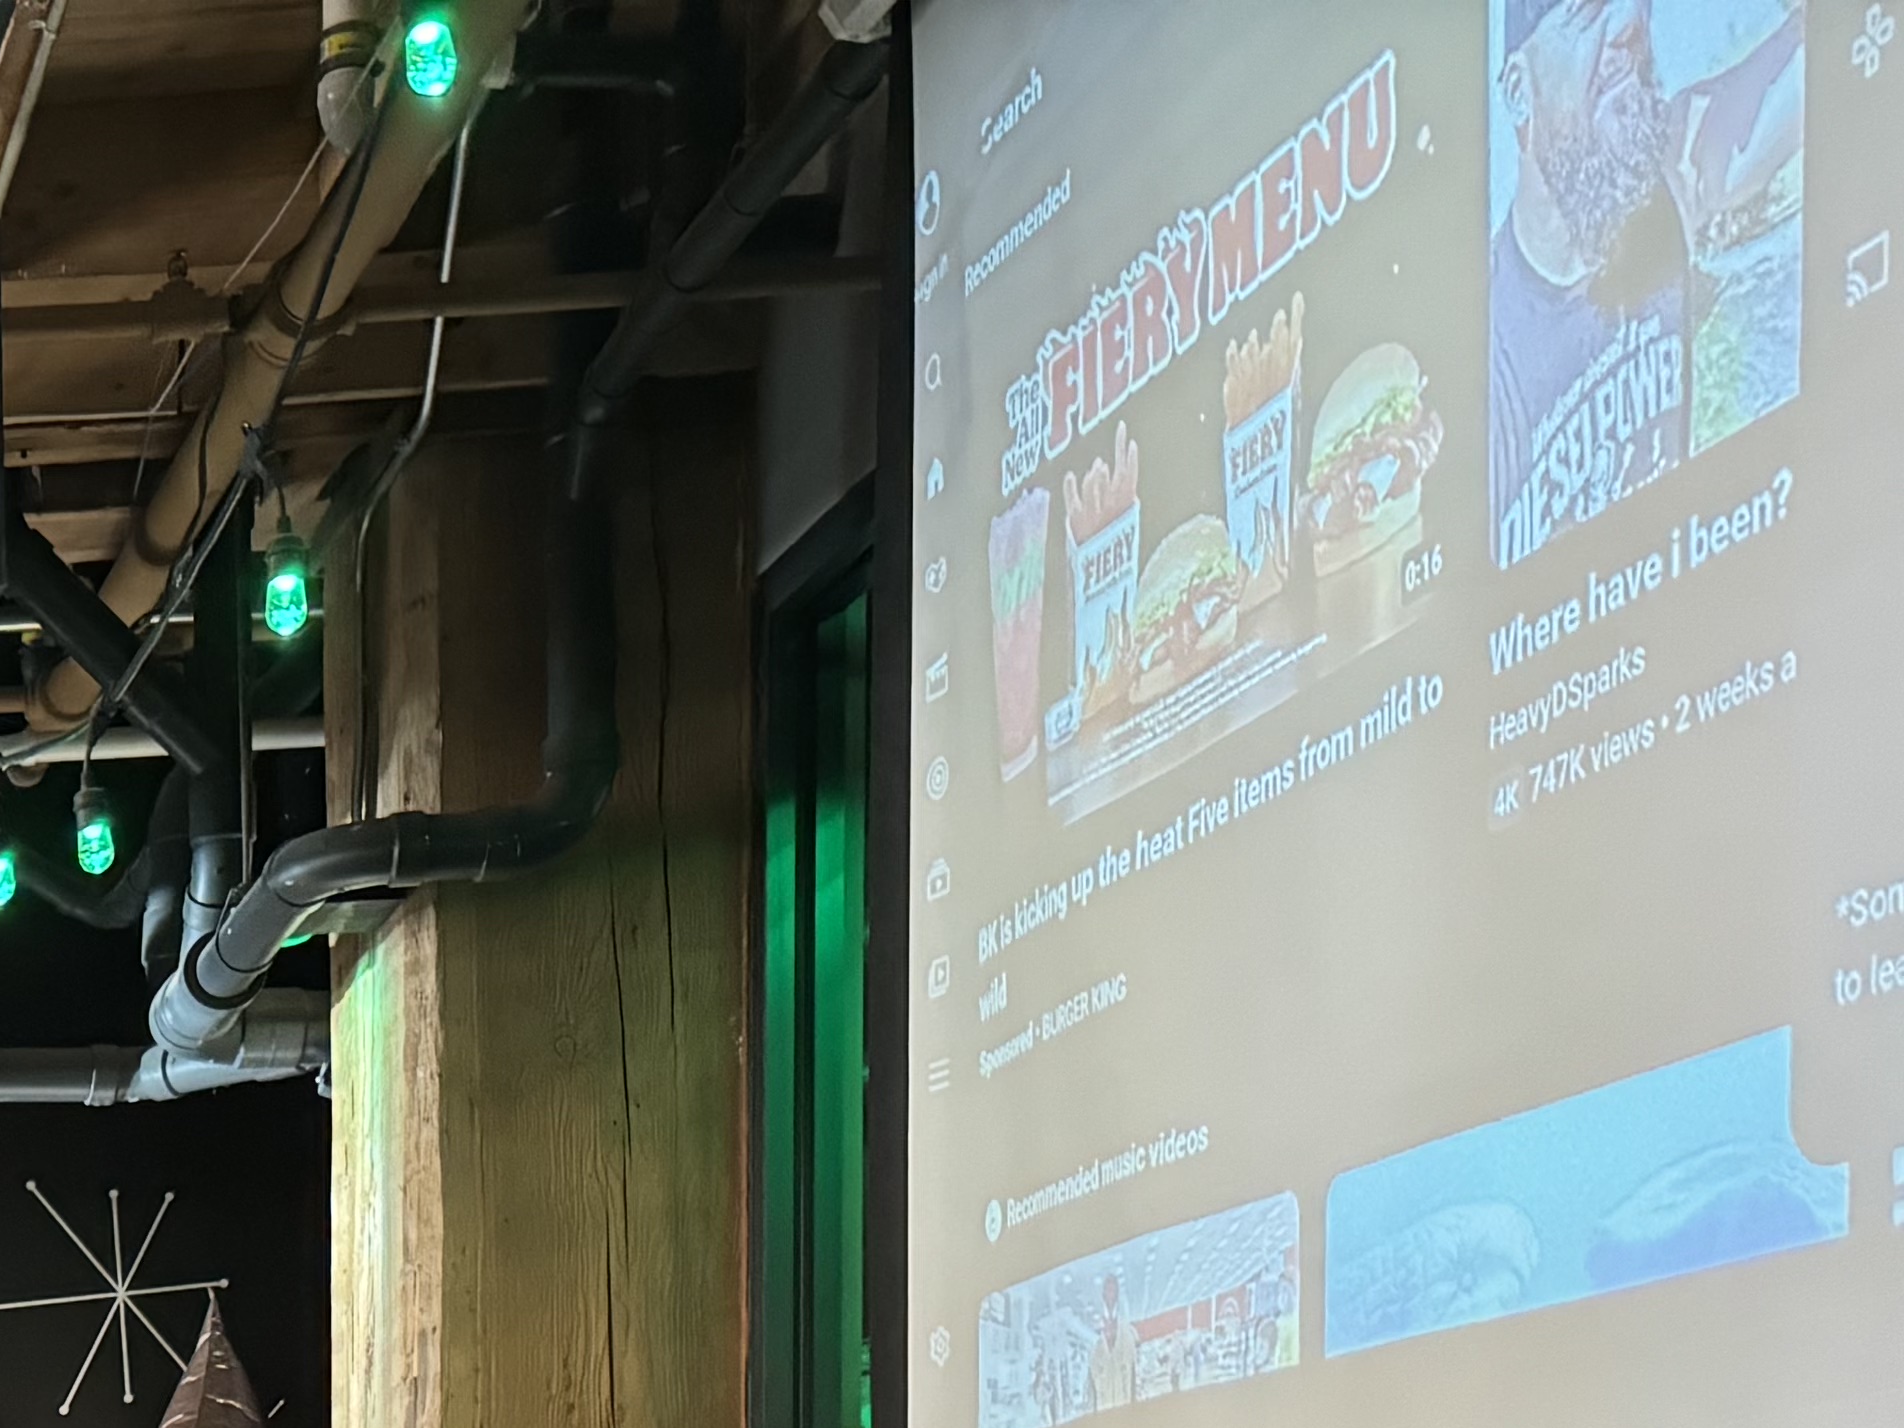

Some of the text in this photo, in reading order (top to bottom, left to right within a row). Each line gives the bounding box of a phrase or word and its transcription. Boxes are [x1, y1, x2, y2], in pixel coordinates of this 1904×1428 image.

[981, 66, 1042, 155] Search
[964, 167, 1071, 298] Recommended
[1039, 48, 1396, 461] FIERY MENU
[1007, 376, 1040, 425] The
[1003, 440, 1040, 495] New
[1230, 409, 1287, 480] FIERY
[1082, 524, 1136, 588] FIERY
[1404, 543, 1444, 592] 0:16
[1489, 466, 1794, 676] Where have i been?
[1489, 646, 1647, 750] HeavyDSparks
[1494, 779, 1520, 818] 4K
[1528, 744, 1587, 804] 747K
[1590, 718, 1655, 773] views
[1674, 694, 1691, 734] 2
[1696, 659, 1775, 723] weeks
[977, 673, 1444, 965] BK is kicking up the heat Five items from mild to
[978, 971, 1008, 1023] wild
[1041, 990, 1090, 1041] BURGER
[1091, 972, 1128, 1013] KING
[1834, 967, 1862, 1006] to
[1006, 1124, 1209, 1229] Recommended music videos
